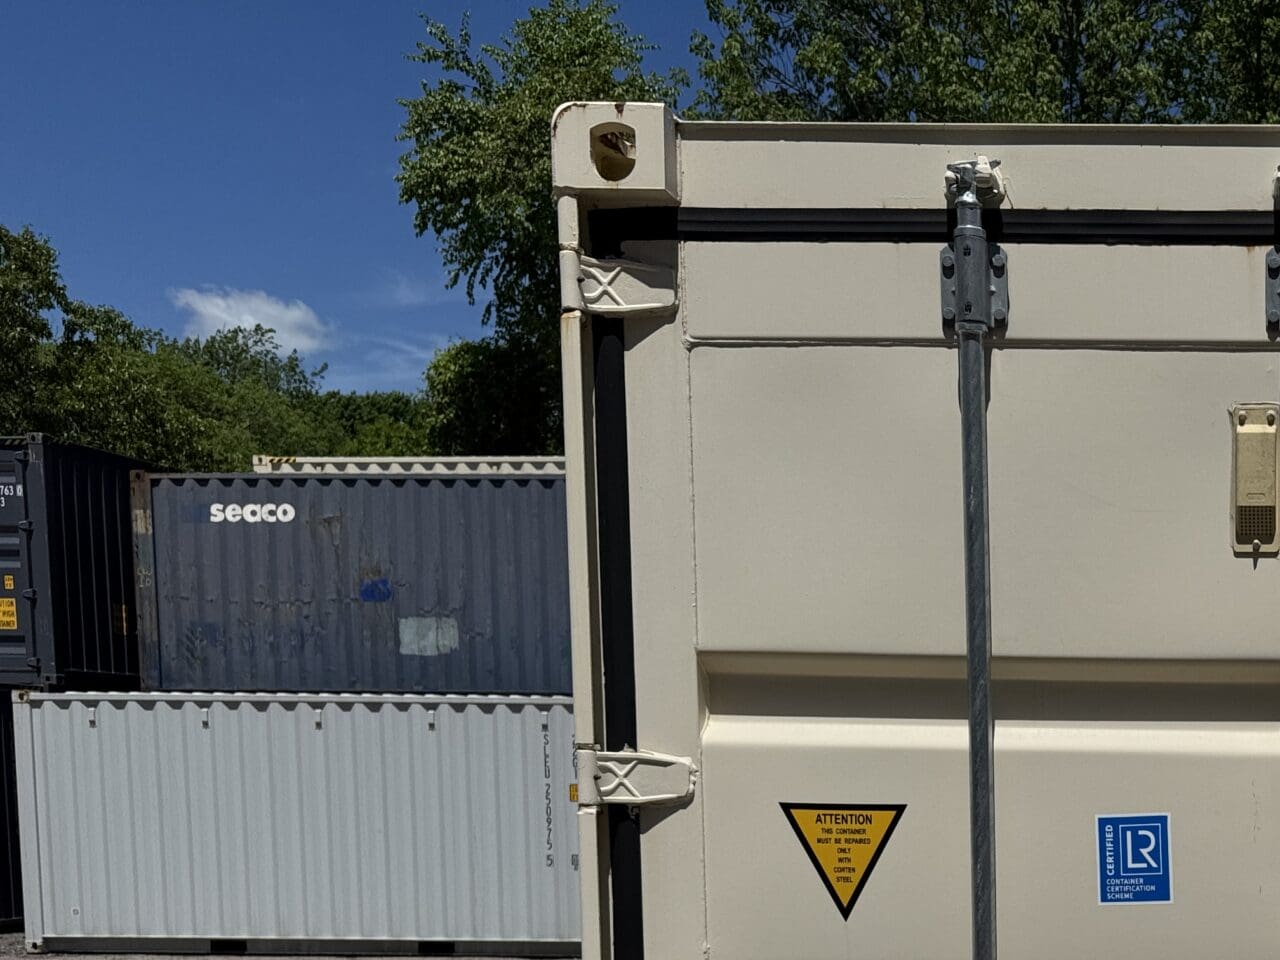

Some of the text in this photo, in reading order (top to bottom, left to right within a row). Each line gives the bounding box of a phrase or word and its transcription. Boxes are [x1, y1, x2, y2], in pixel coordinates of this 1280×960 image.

[209, 503, 296, 523] seaco
[815, 814, 873, 825] ATTENTION
[821, 827, 834, 835] THIS
[816, 837, 871, 845] MUST BE REPAIRED
[837, 847, 851, 855] ONLY
[1105, 824, 1115, 876] CERTIFIED
[1126, 830, 1159, 868] LR
[833, 866, 856, 874] CORTEN
[836, 876, 853, 884] STEEL
[1106, 877, 1144, 885] CONTAINER
[1106, 885, 1156, 893] CERTIFICATION
[1107, 892, 1134, 900] SCHEME
